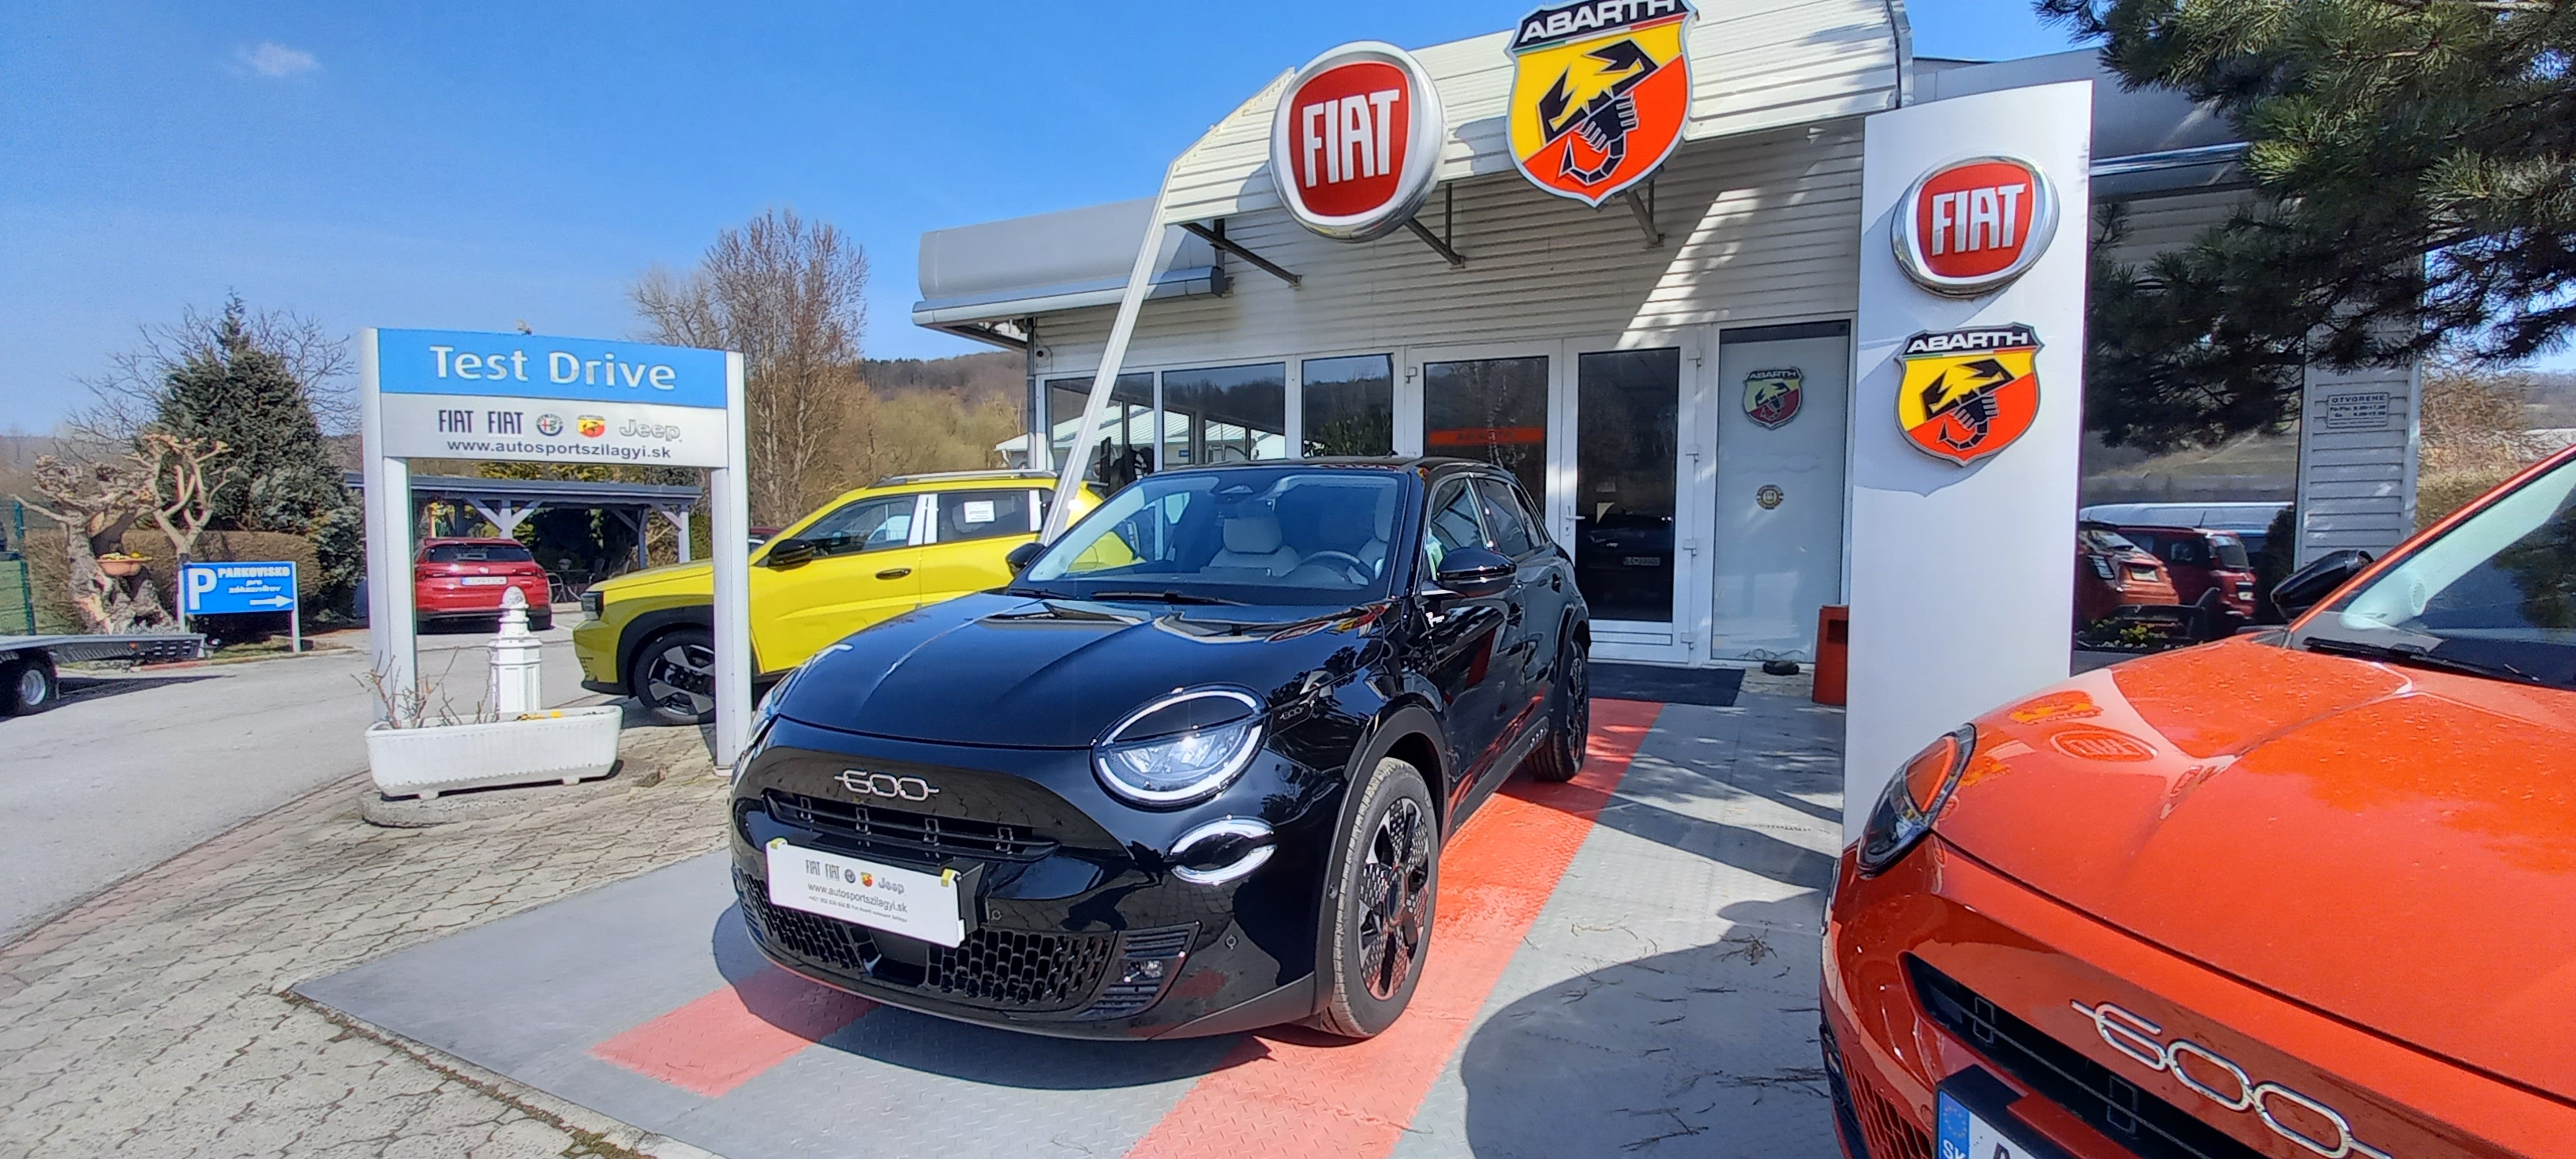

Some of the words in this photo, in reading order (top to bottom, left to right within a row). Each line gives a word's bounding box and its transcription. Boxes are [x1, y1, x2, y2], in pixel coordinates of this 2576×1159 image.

[1519, 0, 1676, 43] ABARTH
[1301, 88, 1400, 188] FIAT
[1930, 182, 2027, 257] FIAT
[1907, 331, 2028, 354] ABARTH
[429, 345, 530, 382] Test
[549, 351, 677, 391] Drive
[1749, 370, 1797, 379] ABARTH
[438, 409, 474, 433] FIAT
[487, 410, 525, 435] FIAT
[619, 419, 681, 442] Jeep
[447, 439, 672, 459] www.autosportszilagyi.sk
[187, 567, 218, 610] P
[217, 566, 290, 579] PARKOVISKO
[833, 768, 940, 801] 600
[805, 859, 821, 876] FIAT
[825, 863, 841, 881] FIAT
[878, 877, 905, 895] Jeep
[807, 883, 908, 913] www.autosportszilagyi.sk
[2069, 999, 2392, 1159] 600
